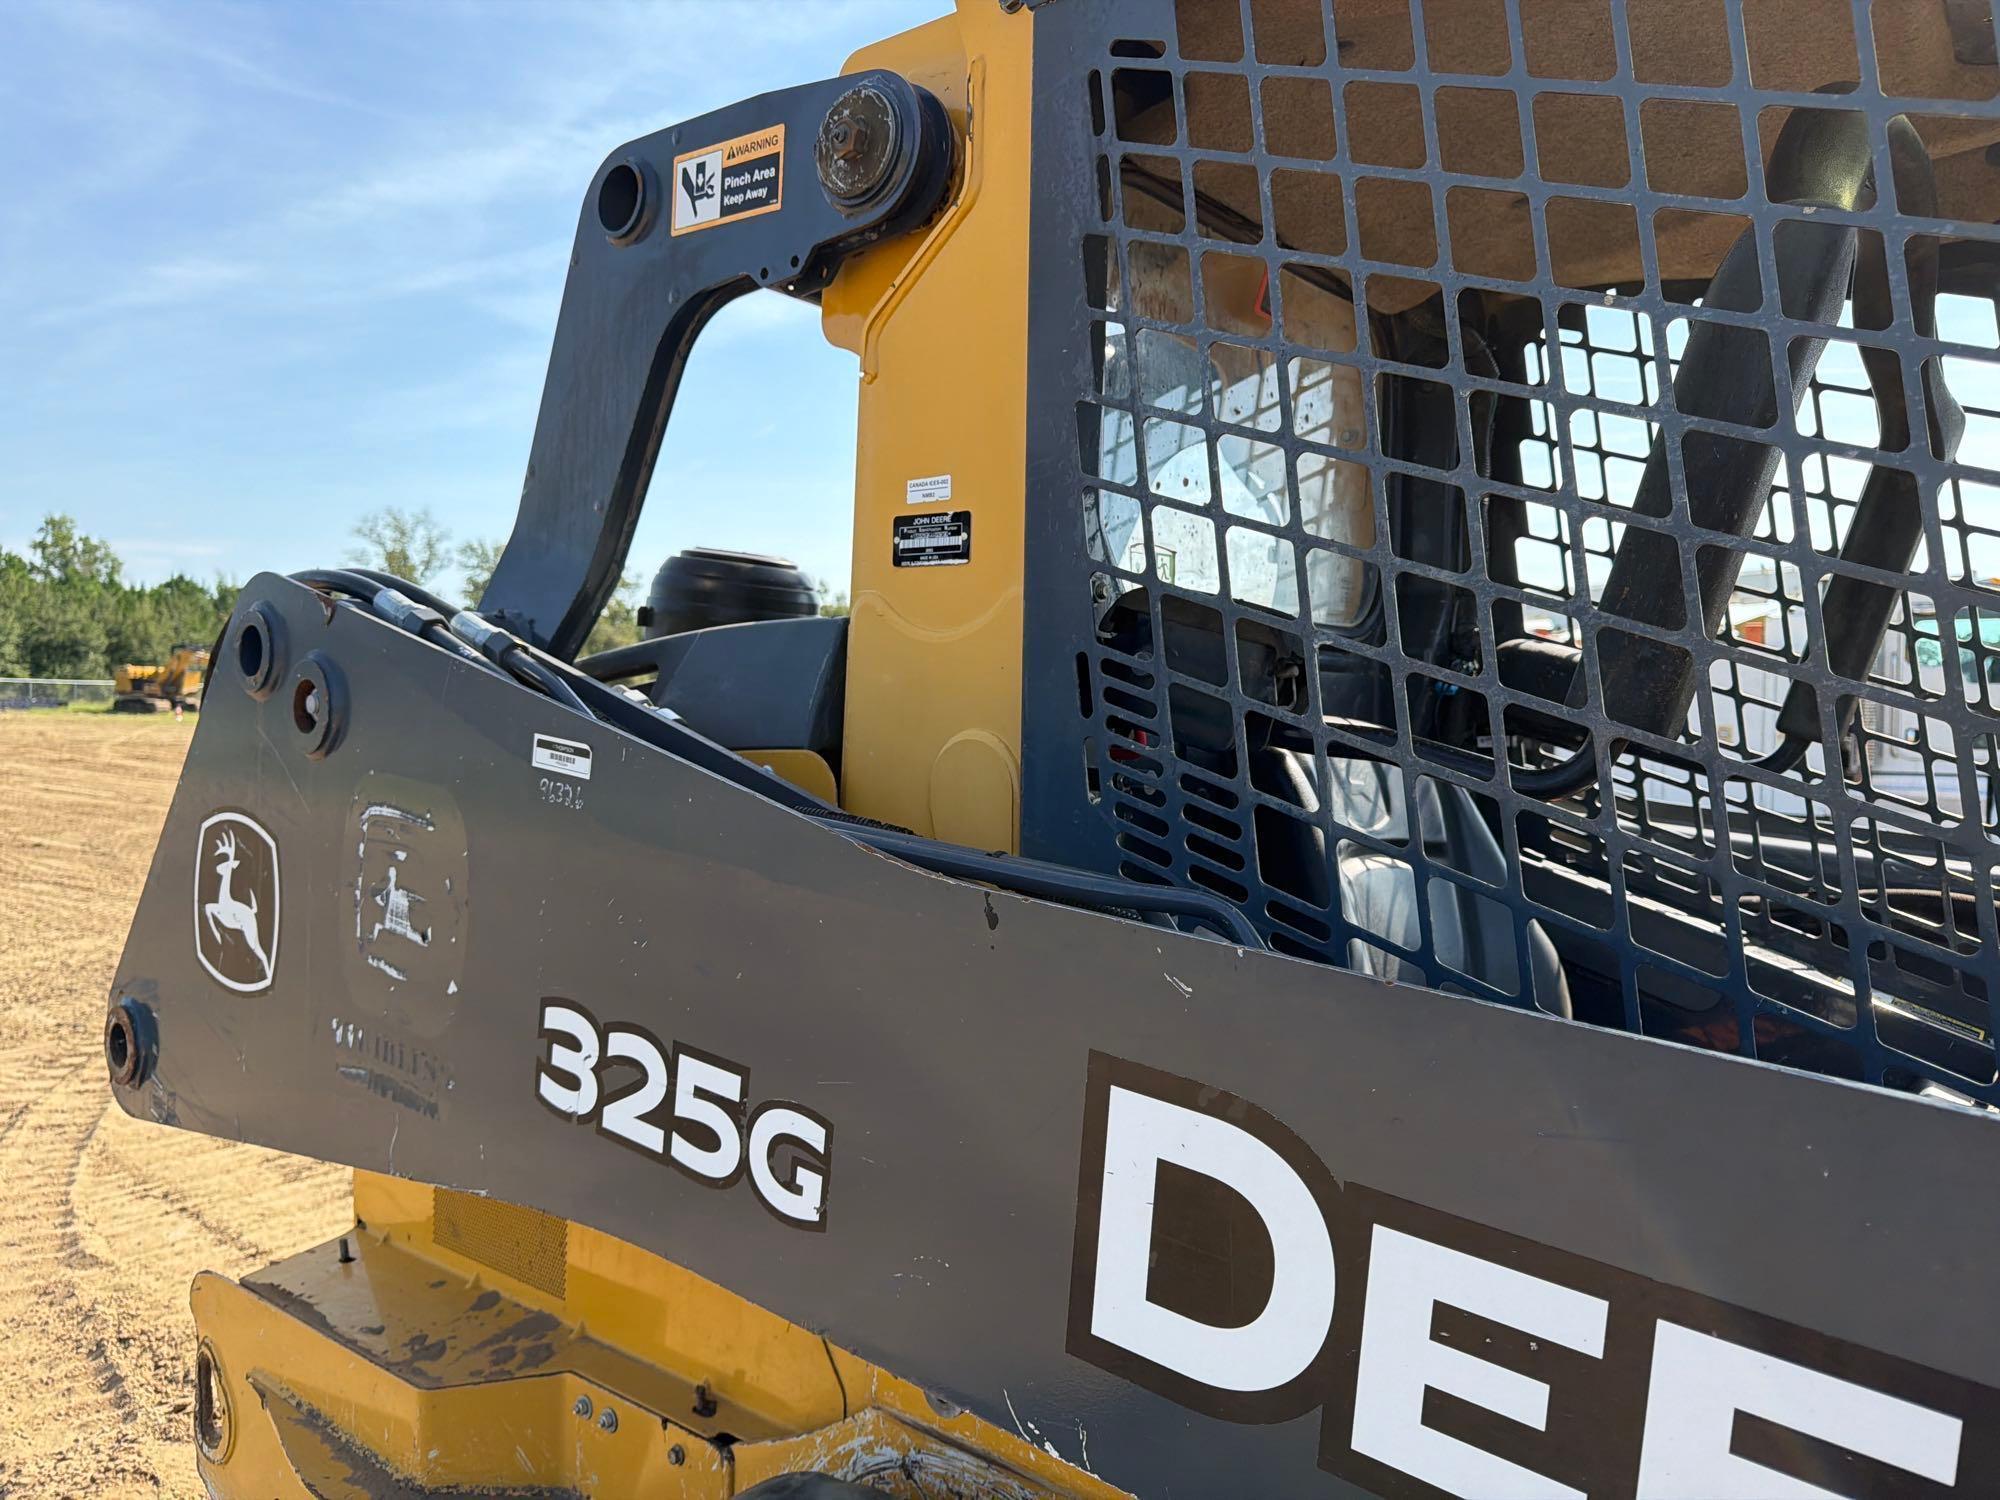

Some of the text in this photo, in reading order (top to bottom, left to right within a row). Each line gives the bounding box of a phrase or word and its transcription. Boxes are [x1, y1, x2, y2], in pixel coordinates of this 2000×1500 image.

[735, 134, 779, 156] WARNING
[724, 166, 776, 190] Pinch Area
[723, 186, 768, 207] Keep Away
[909, 481, 928, 489] CANADA
[913, 515, 952, 526] JOHN DEERE
[539, 1006, 826, 1222] 325G
